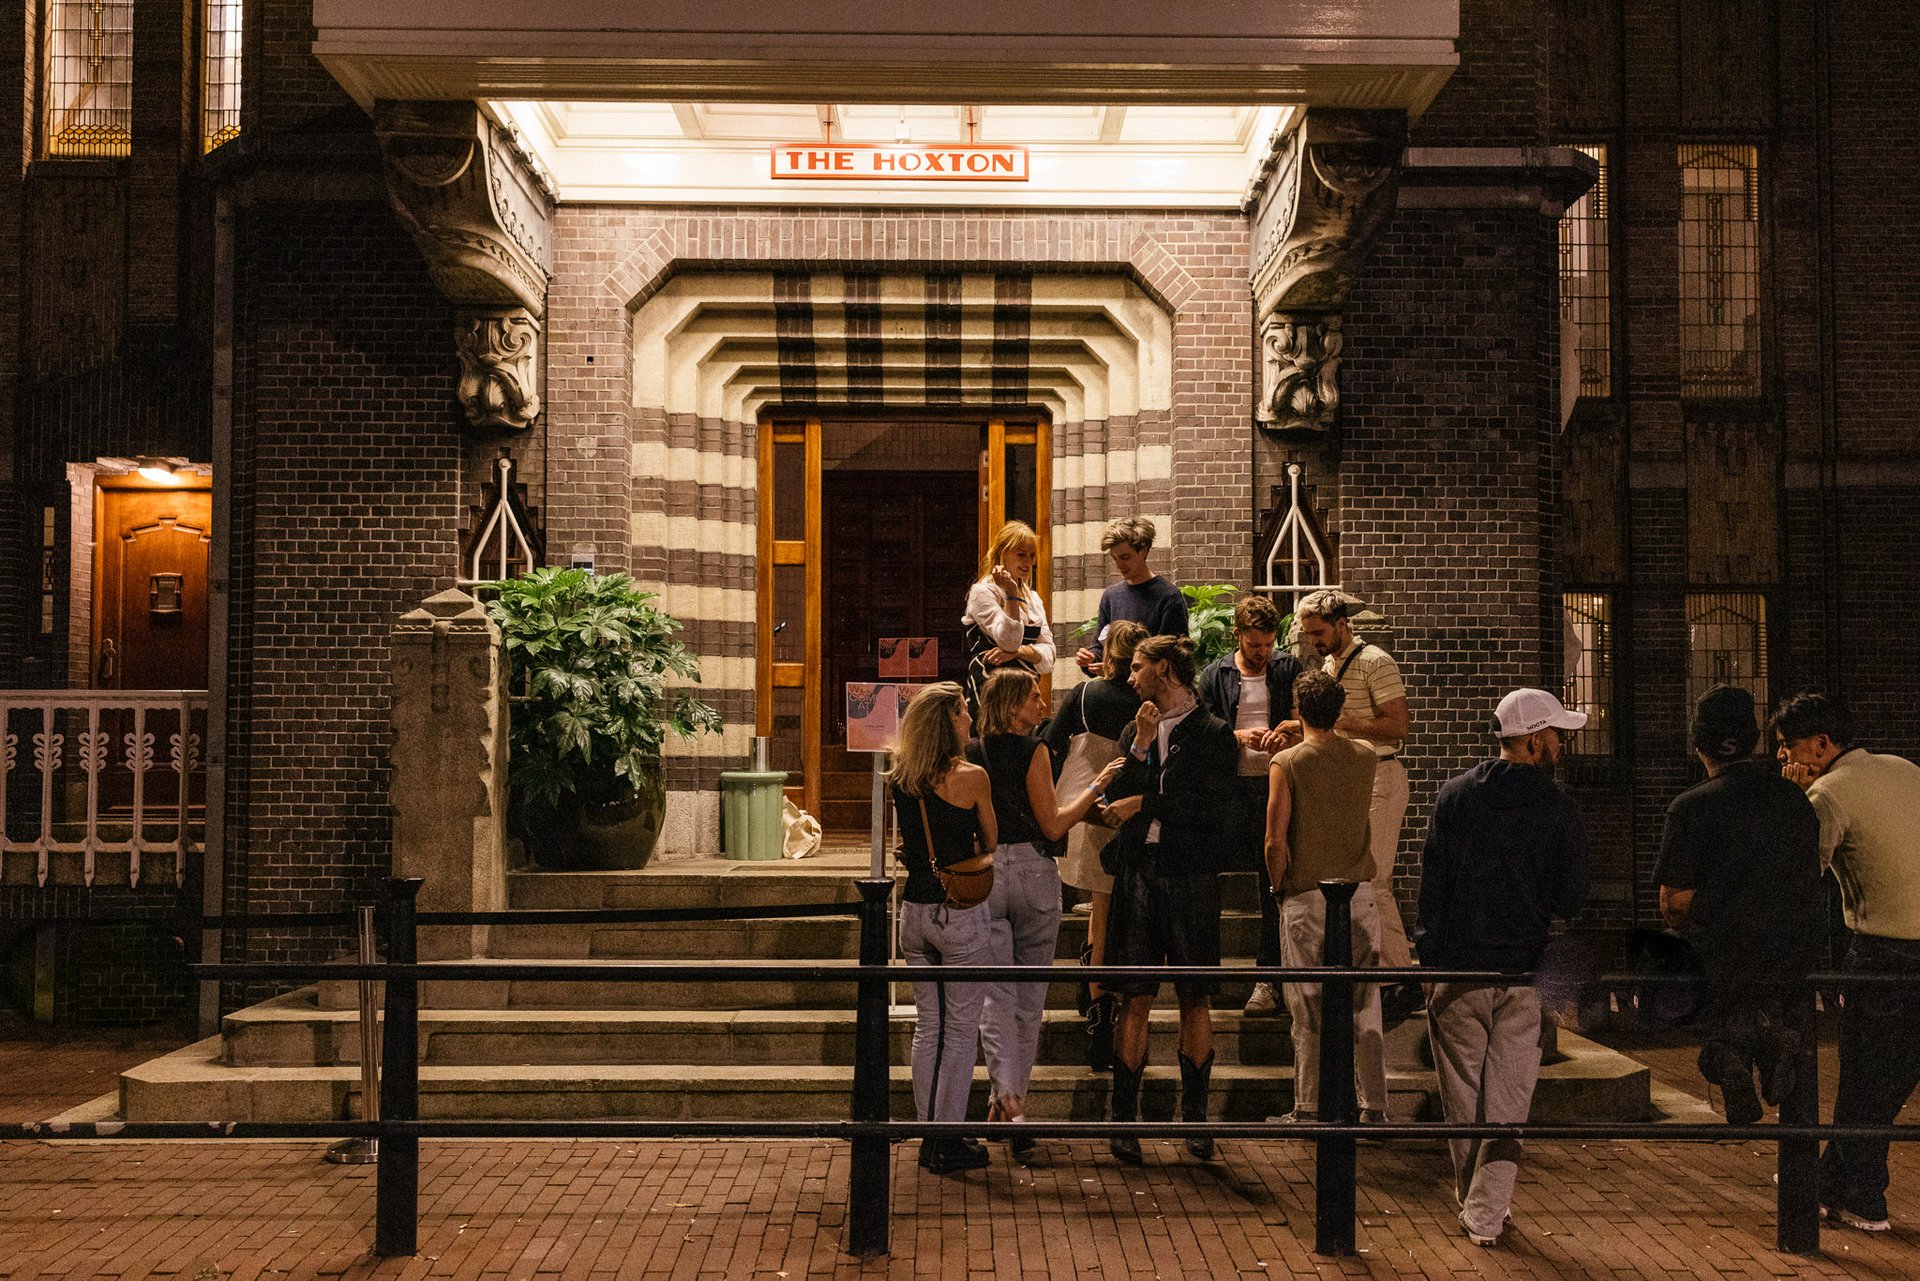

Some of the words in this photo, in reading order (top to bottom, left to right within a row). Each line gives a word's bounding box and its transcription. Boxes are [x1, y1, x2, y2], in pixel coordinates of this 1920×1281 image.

[786, 151, 854, 170] THE
[873, 152, 1014, 173] HOXTON
[1527, 719, 1548, 731] NOCTA
